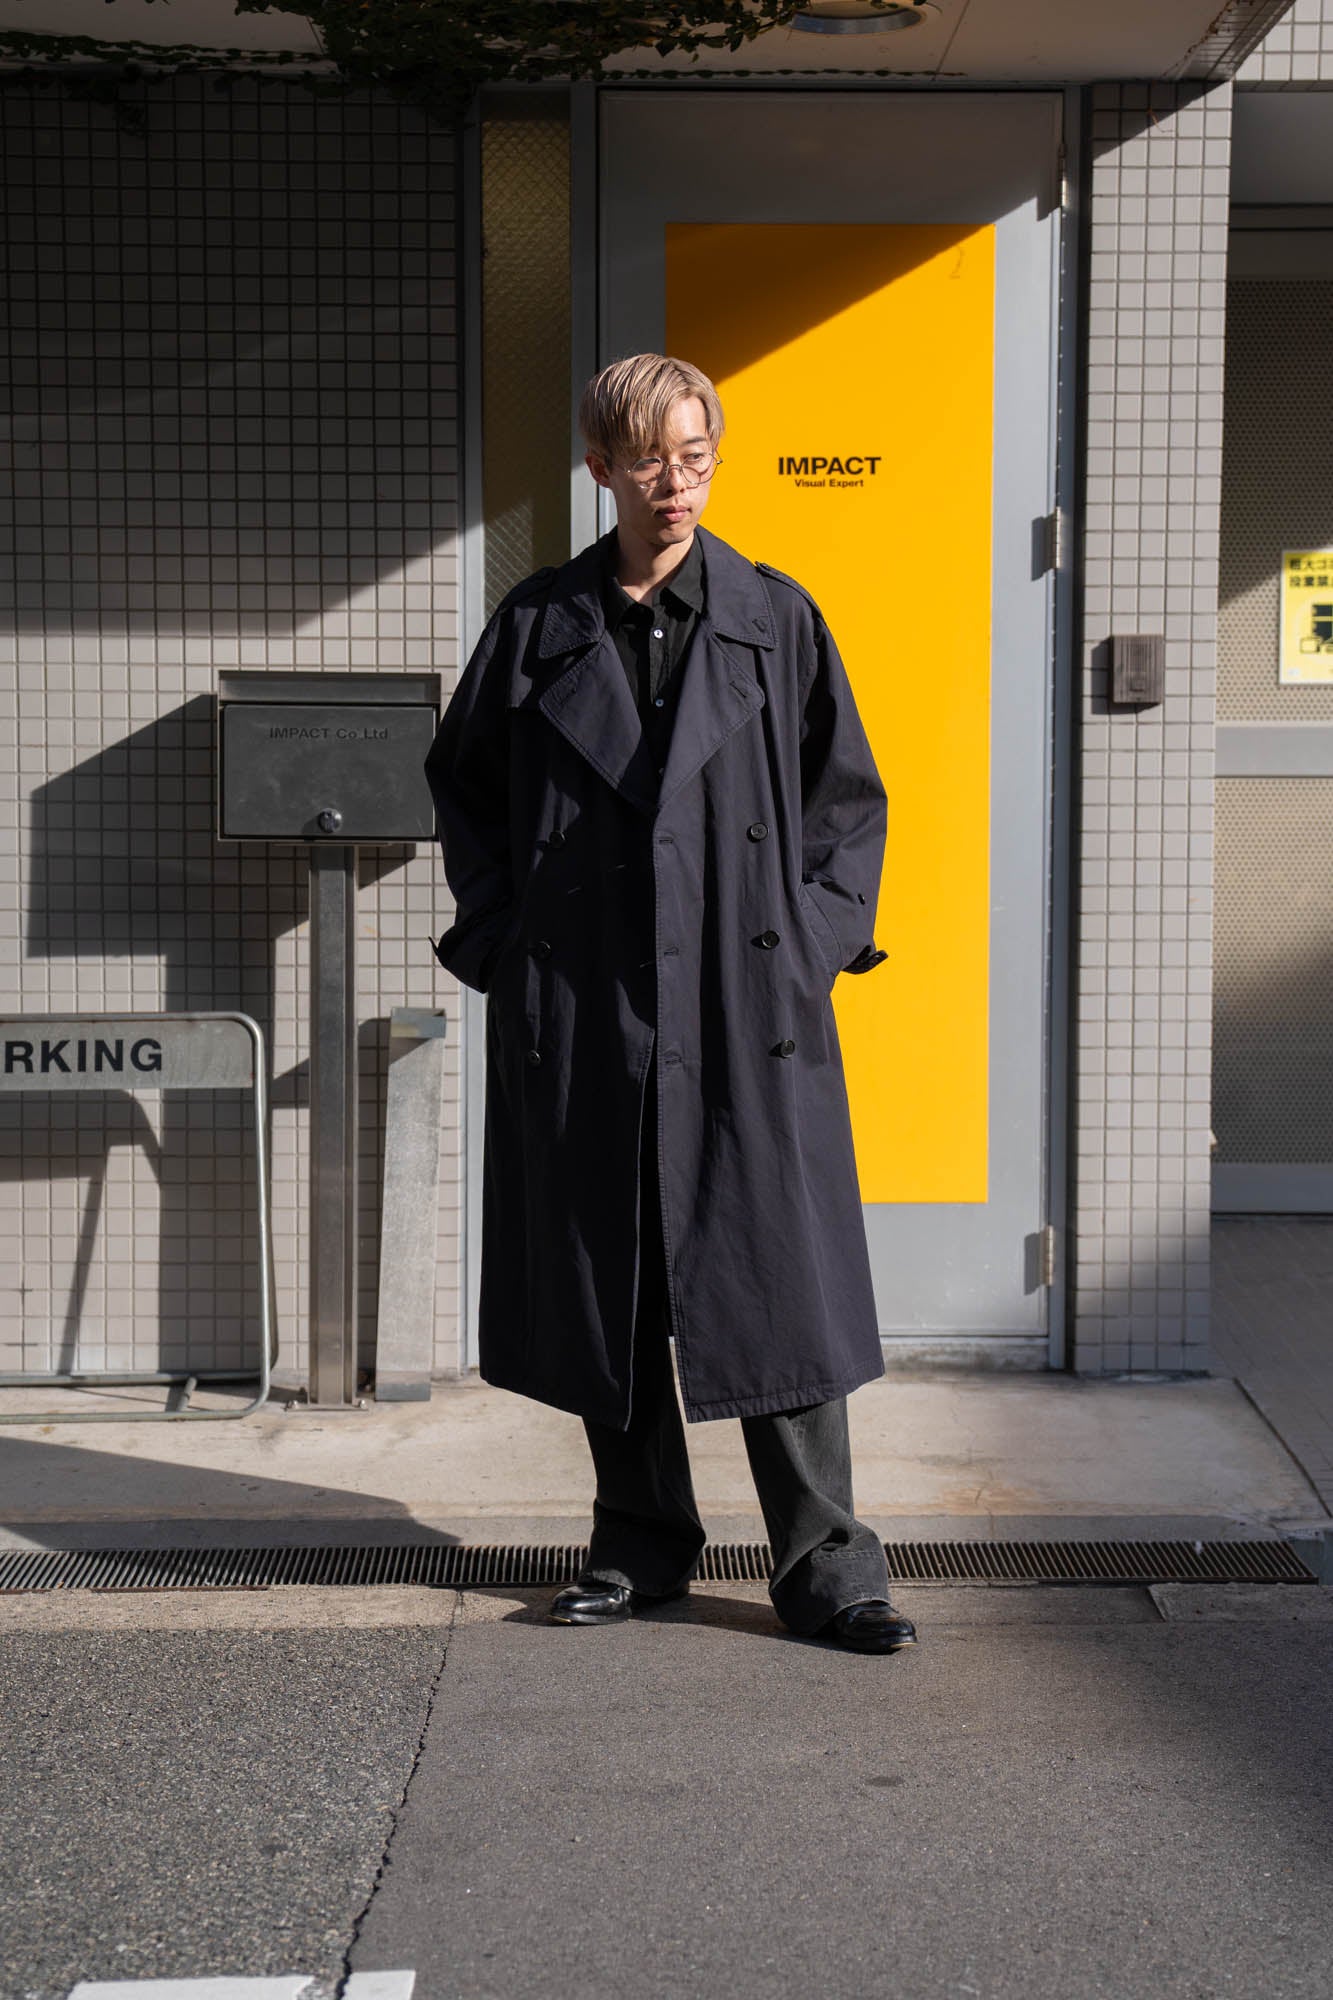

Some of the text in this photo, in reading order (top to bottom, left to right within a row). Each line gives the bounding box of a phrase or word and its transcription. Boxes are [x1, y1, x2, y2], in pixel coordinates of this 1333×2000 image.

[778, 456, 882, 475] IMPACT
[794, 479, 864, 489] Visual Expert
[269, 727, 330, 739] IMPACT
[4, 1038, 163, 1073] RKING
